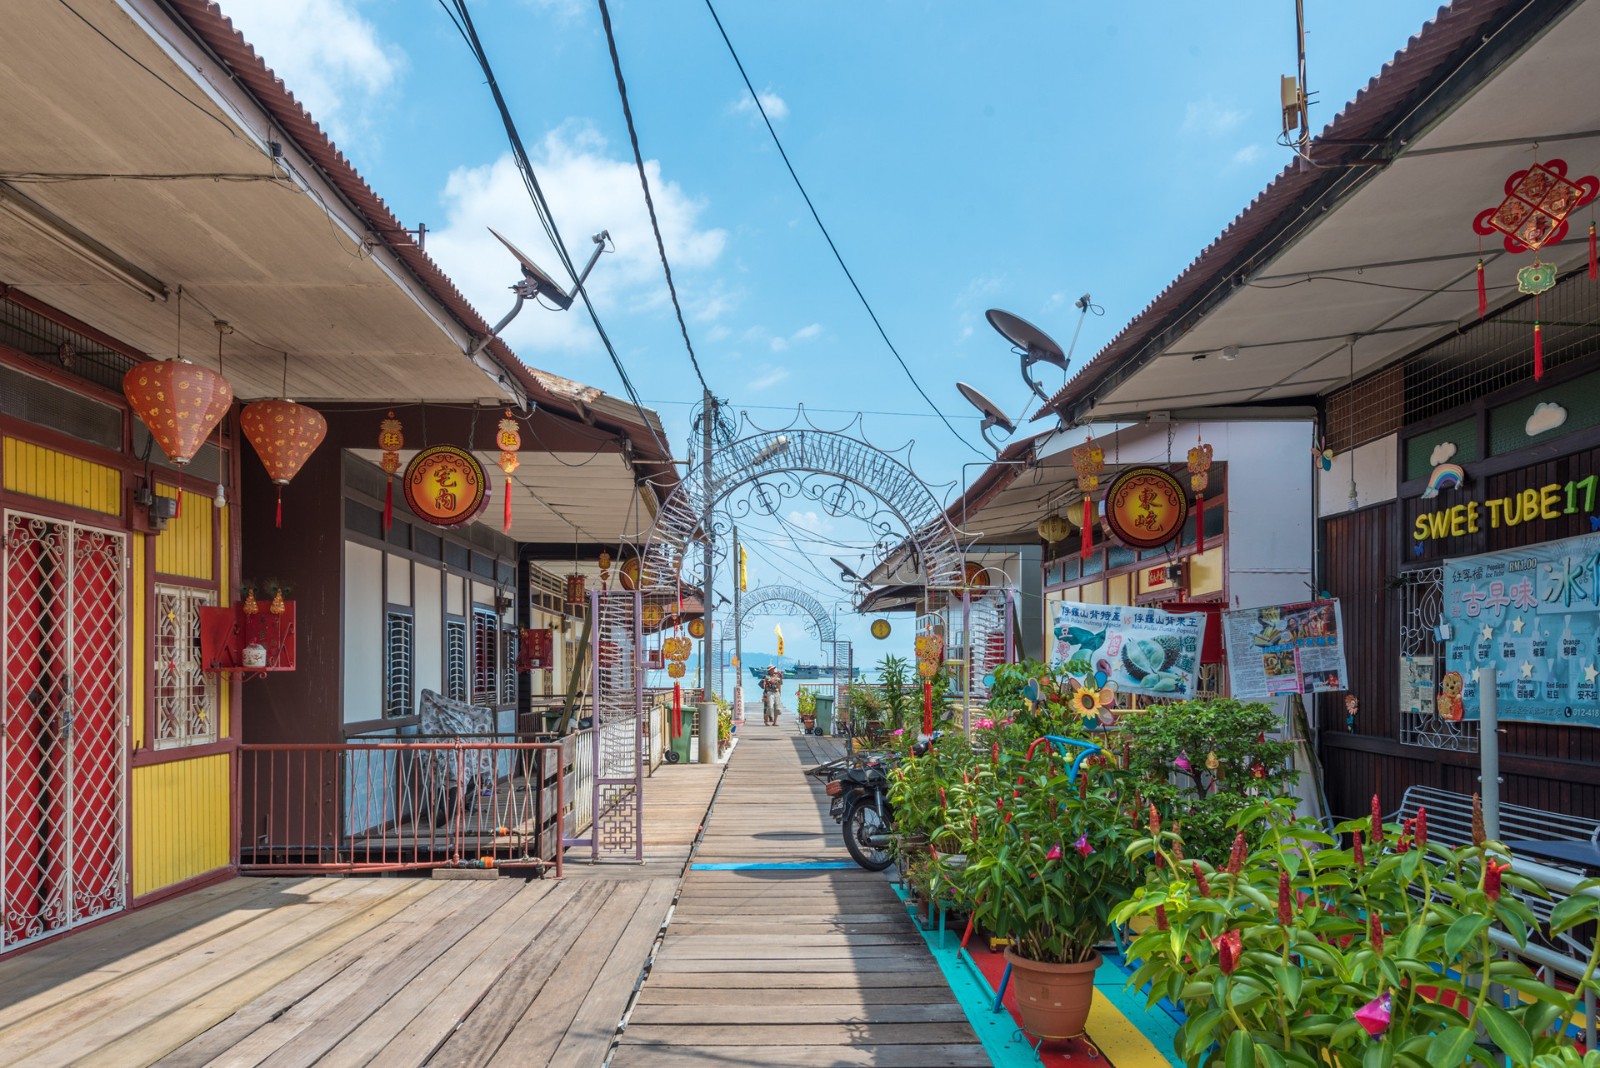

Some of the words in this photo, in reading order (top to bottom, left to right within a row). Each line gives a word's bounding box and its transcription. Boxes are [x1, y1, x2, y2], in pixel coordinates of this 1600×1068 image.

[384, 432, 399, 446] 旺
[501, 432, 517, 446] 旺
[1413, 501, 1479, 541] SWEE
[1462, 575, 1539, 617] 古早味
